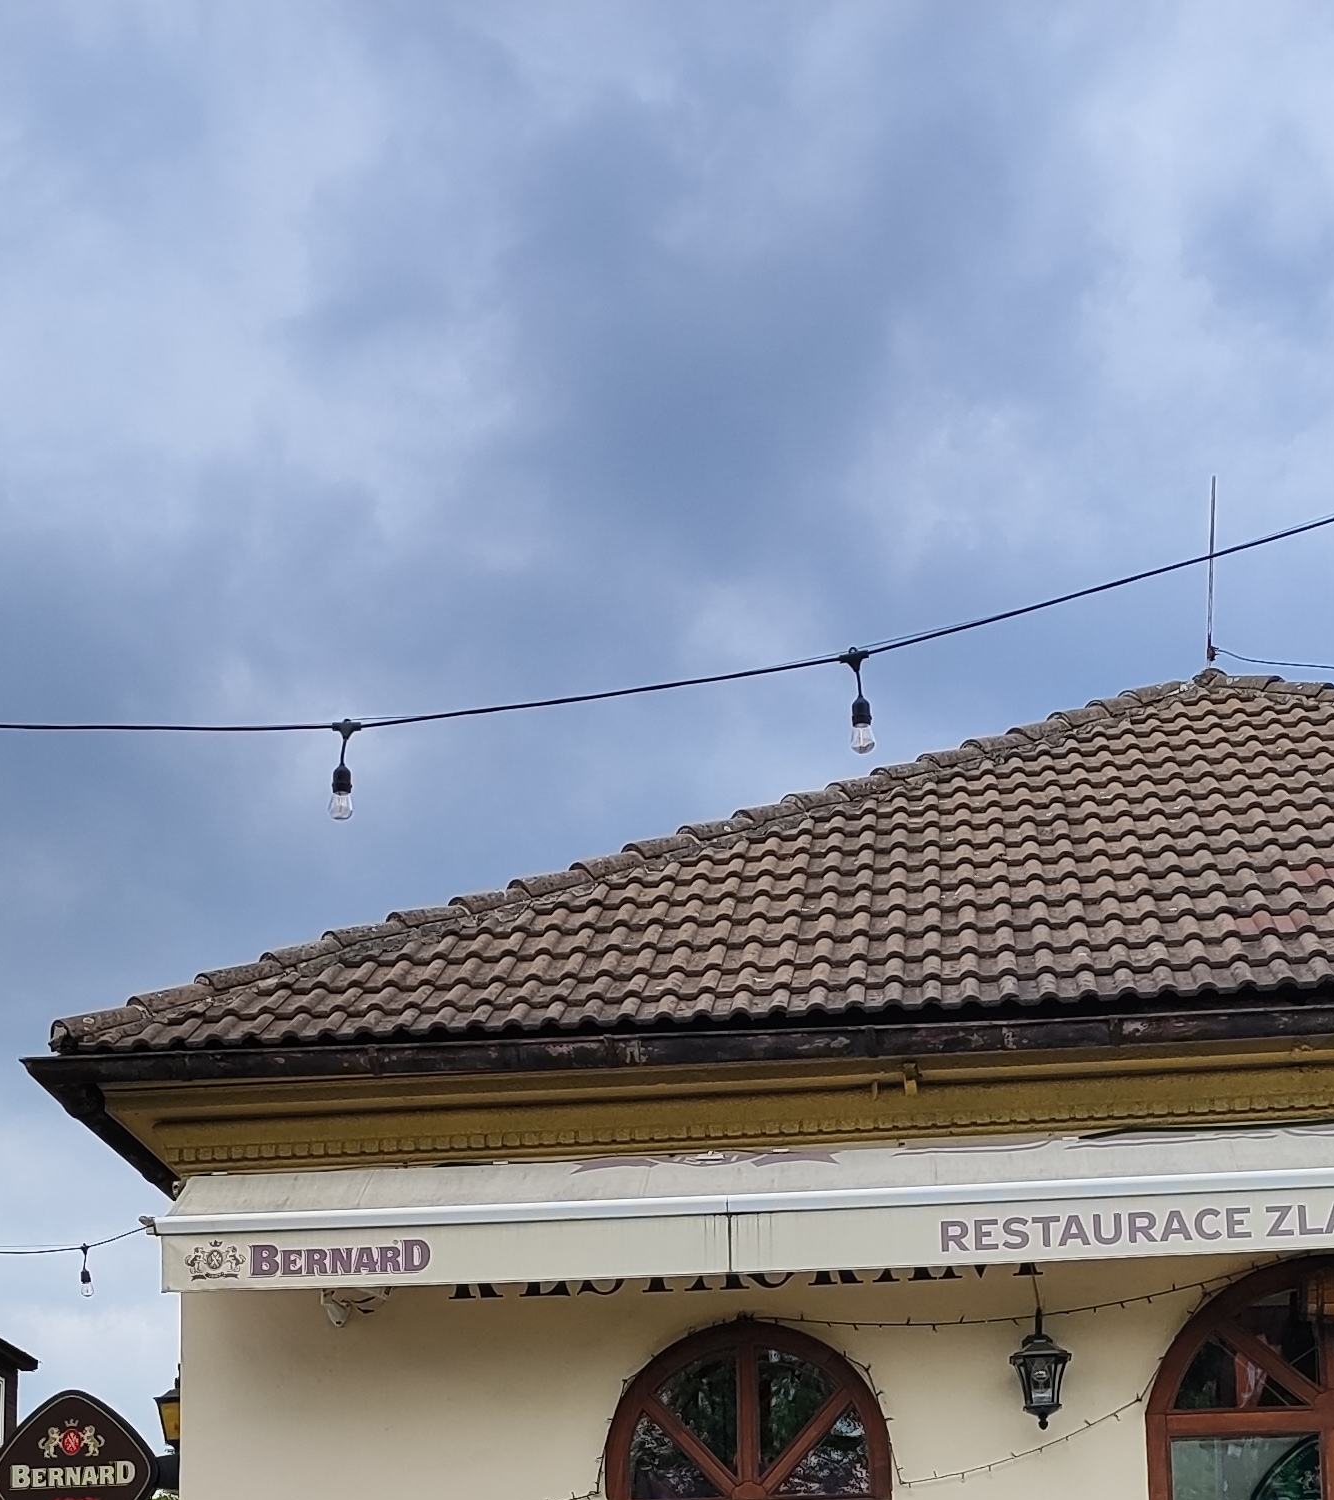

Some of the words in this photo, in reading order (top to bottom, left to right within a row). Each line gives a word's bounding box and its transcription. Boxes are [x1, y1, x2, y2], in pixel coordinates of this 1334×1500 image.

[940, 1206, 1252, 1253] RESTAURACE
[247, 1238, 432, 1280] BERNARD
[9, 1461, 136, 1491] BERNARD
